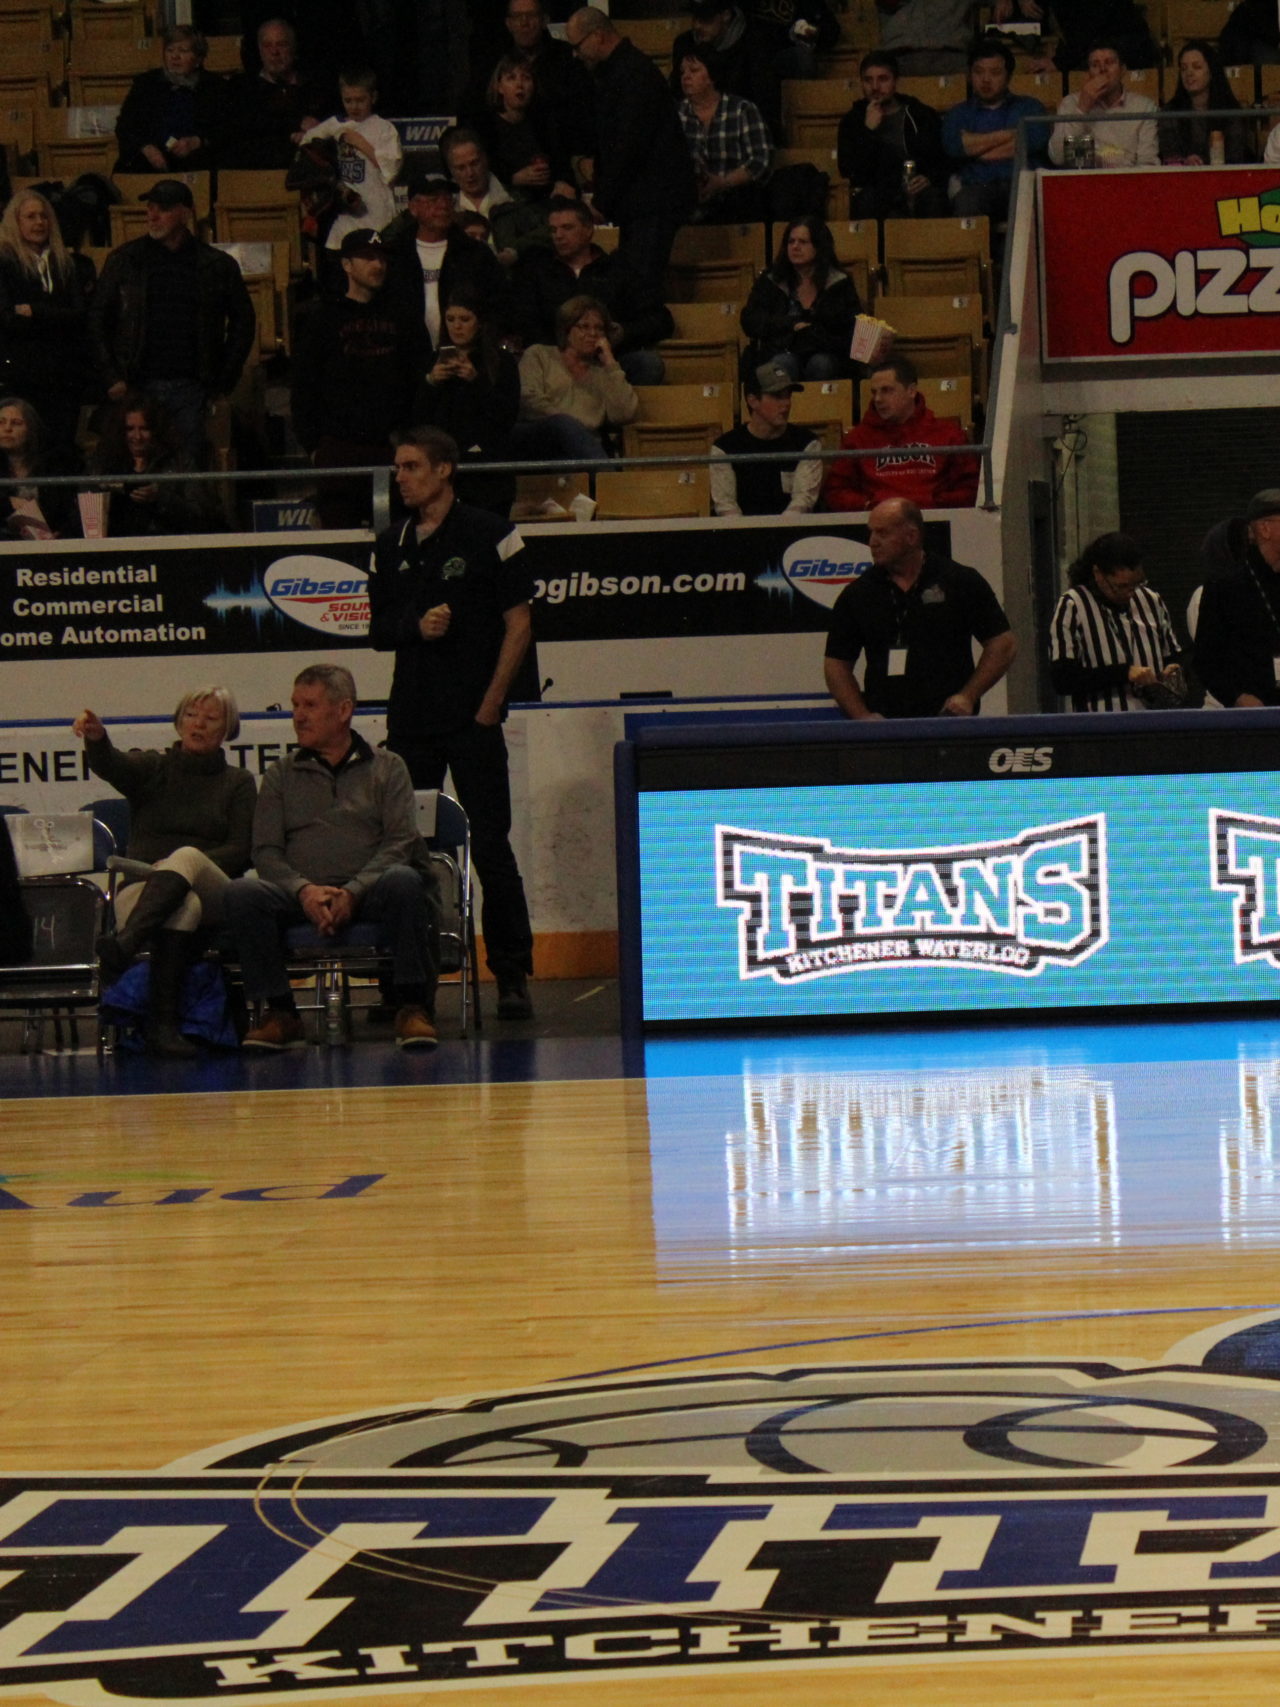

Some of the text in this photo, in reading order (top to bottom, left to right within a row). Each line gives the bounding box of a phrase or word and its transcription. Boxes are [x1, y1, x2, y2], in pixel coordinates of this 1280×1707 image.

[16, 564, 157, 587] Residential
[13, 594, 163, 617] Commercial
[320, 612, 329, 622] &
[0, 624, 207, 647] ome Automation
[988, 747, 1055, 773] OES
[732, 834, 1091, 960] TITANS
[785, 937, 1031, 974] KITCHENER WATERLOO
